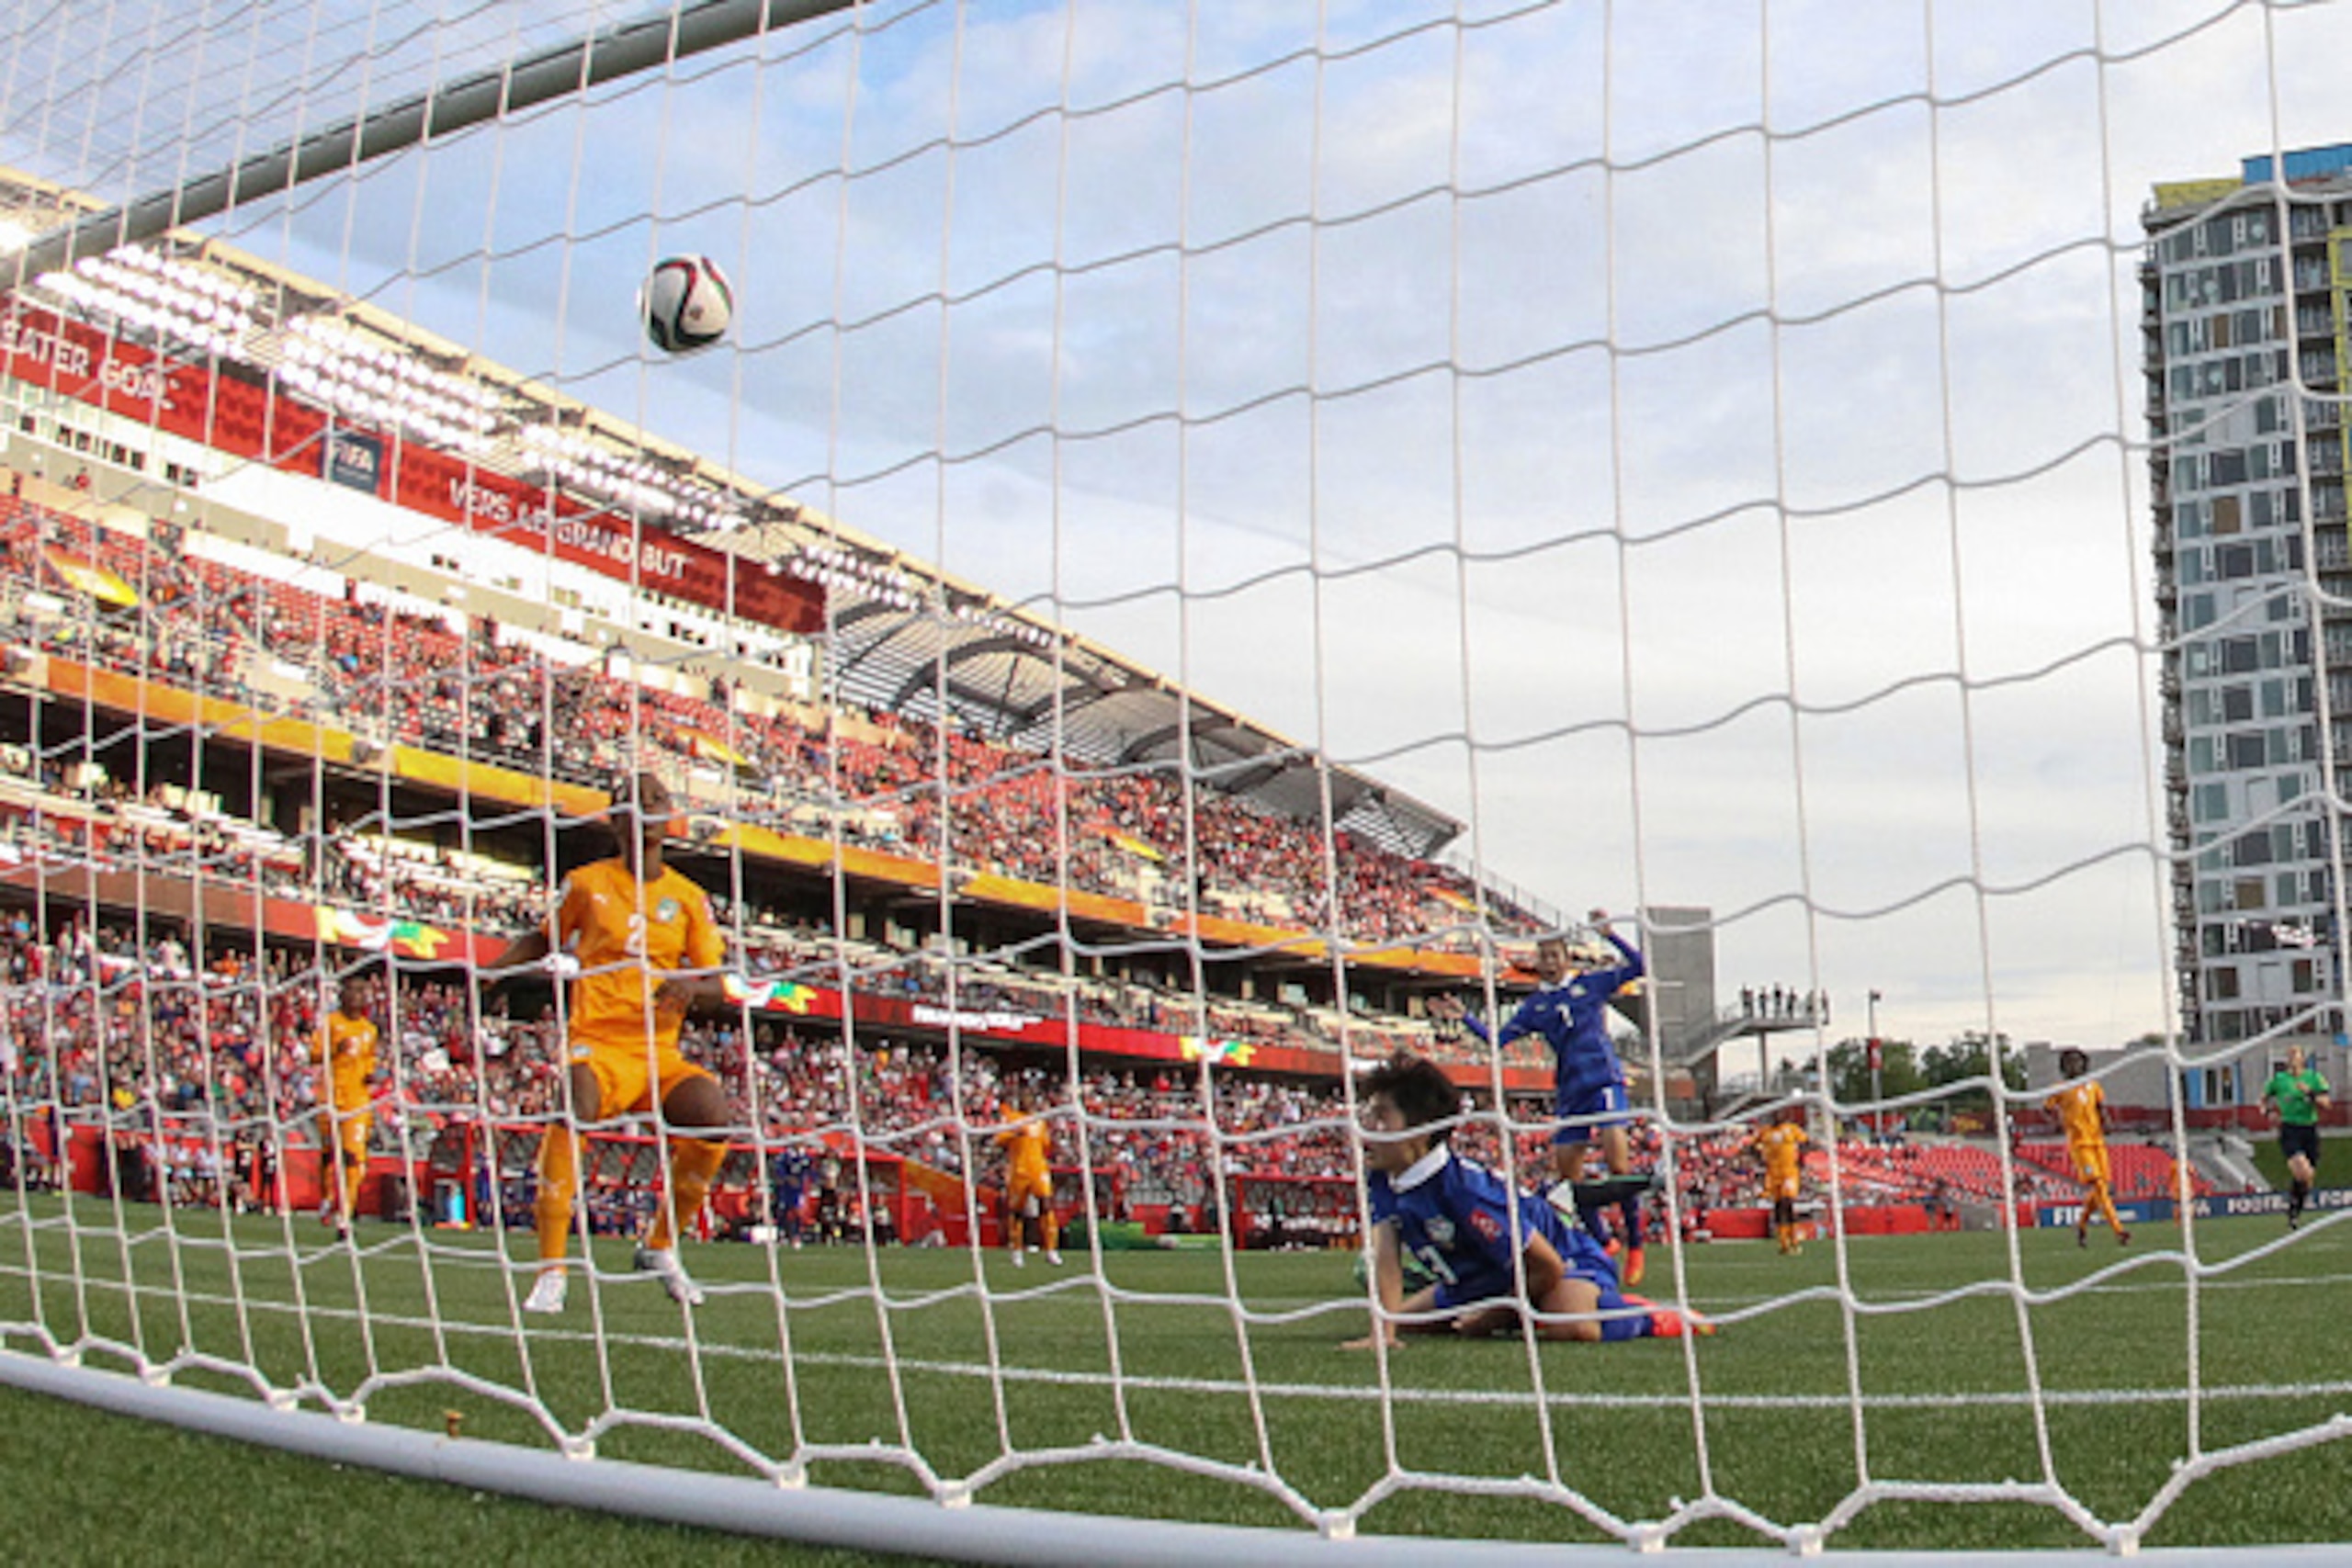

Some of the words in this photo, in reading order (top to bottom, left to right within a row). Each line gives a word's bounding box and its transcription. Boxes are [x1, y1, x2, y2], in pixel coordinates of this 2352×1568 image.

[449, 477, 512, 522] VERS
[557, 520, 636, 564] GRAND
[640, 540, 687, 579] BUT
[2227, 1194, 2317, 1214] FOOTBL
